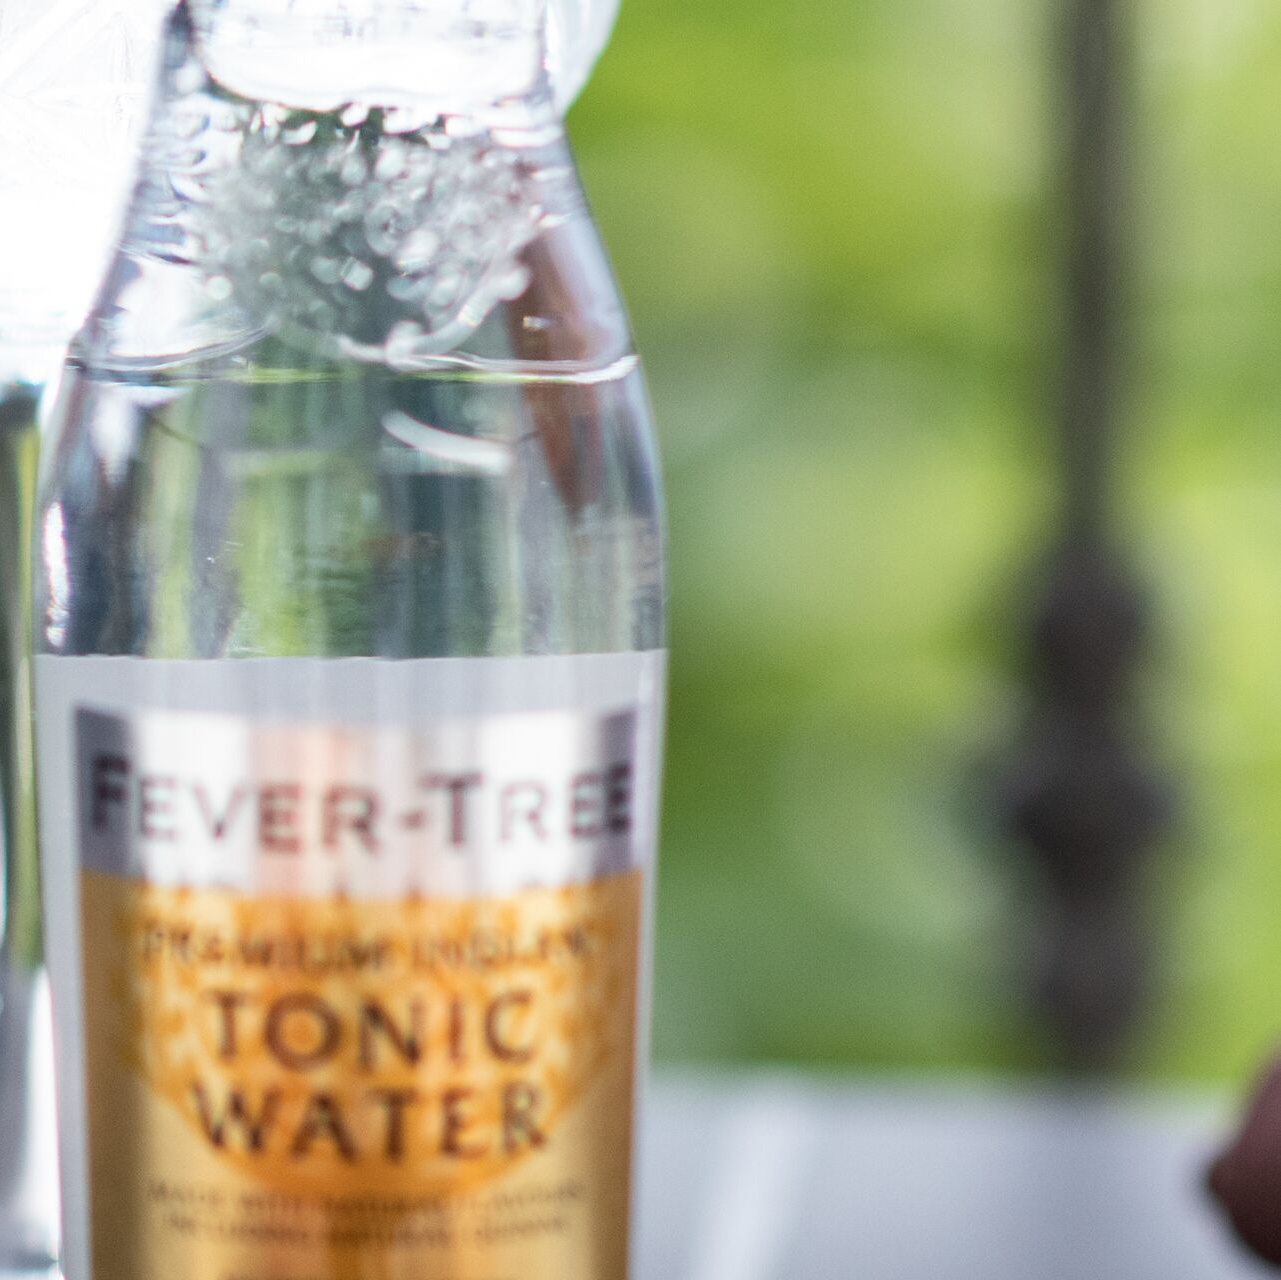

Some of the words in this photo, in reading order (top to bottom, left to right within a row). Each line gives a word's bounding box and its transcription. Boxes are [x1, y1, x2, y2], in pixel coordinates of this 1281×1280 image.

[90, 751, 634, 856] FEVER-TREE
[208, 990, 537, 1072] TONIC
[189, 1082, 549, 1164] WATER
